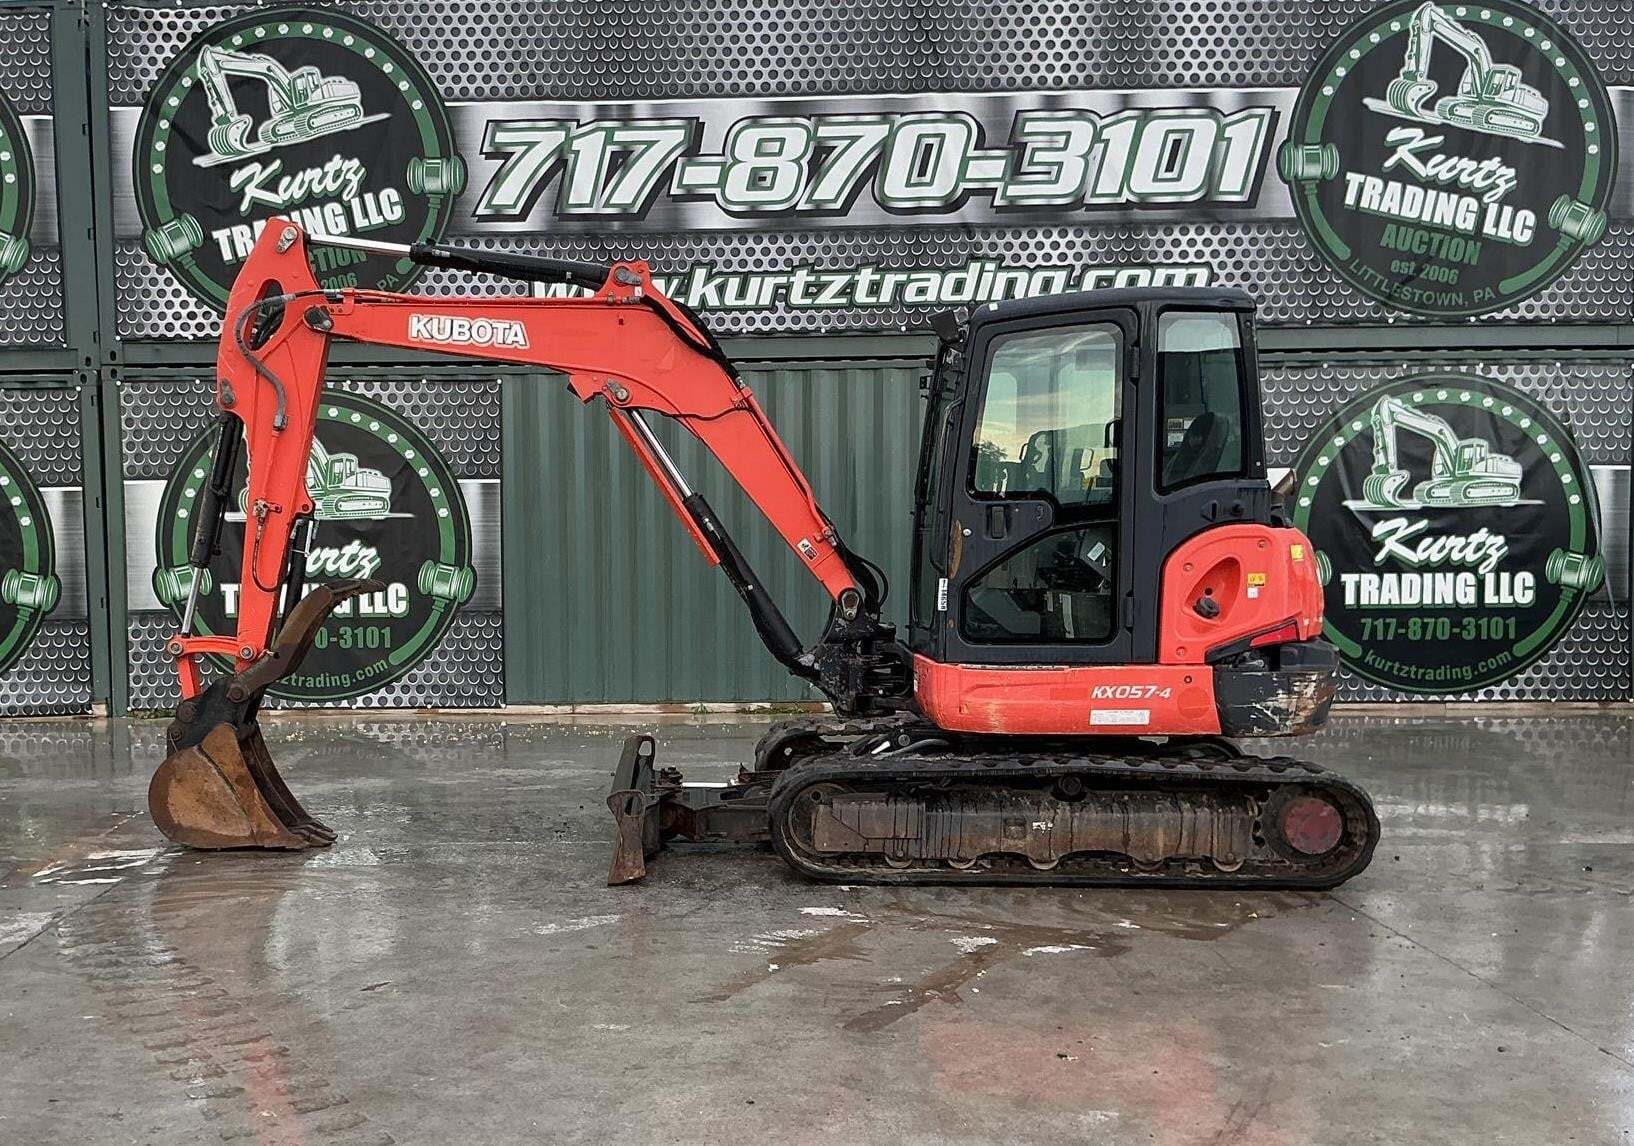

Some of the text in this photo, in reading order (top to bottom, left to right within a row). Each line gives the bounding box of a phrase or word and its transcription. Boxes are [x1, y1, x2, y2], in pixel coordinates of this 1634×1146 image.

[480, 110, 1270, 211] 717-870-3101
[1384, 127, 1518, 203] Kurtz
[230, 153, 366, 213] Kurtz
[211, 187, 404, 261] TRING LLC
[1345, 172, 1537, 243] TRADING LLC
[1380, 223, 1482, 265] AUCTION
[376, 273, 399, 291] PA
[1420, 263, 1460, 286] 2006
[1473, 286, 1497, 304] PA
[410, 315, 528, 346] KUBOTA
[306, 539, 381, 579] urtz
[1372, 517, 1509, 575] Kurtz
[1341, 571, 1536, 606] TRADING LLC
[1361, 616, 1516, 641] 717-870-3101
[1362, 649, 1513, 682] kurtztrading.com
